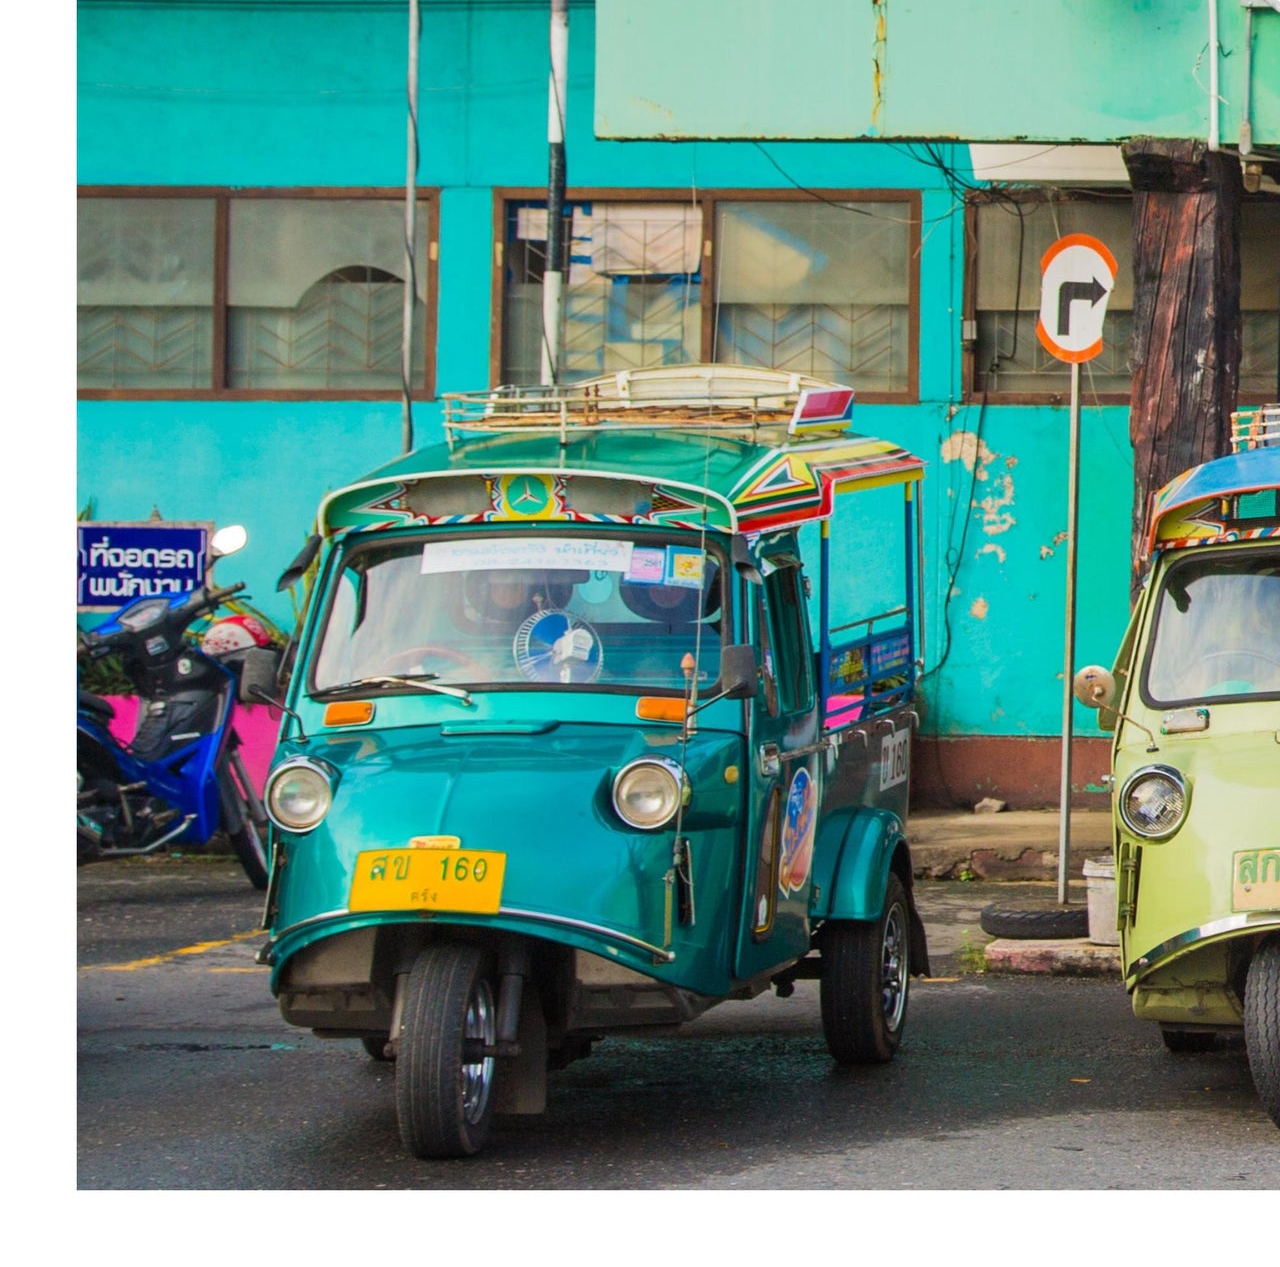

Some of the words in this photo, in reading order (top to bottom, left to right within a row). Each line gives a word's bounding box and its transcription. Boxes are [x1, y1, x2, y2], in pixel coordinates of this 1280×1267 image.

[89, 536, 194, 569] ที่จอดรถ
[890, 738, 908, 780] 160
[369, 854, 411, 881] สข
[440, 856, 488, 882] 160
[1239, 852, 1280, 884] สก
[410, 888, 438, 903] ตรัง
